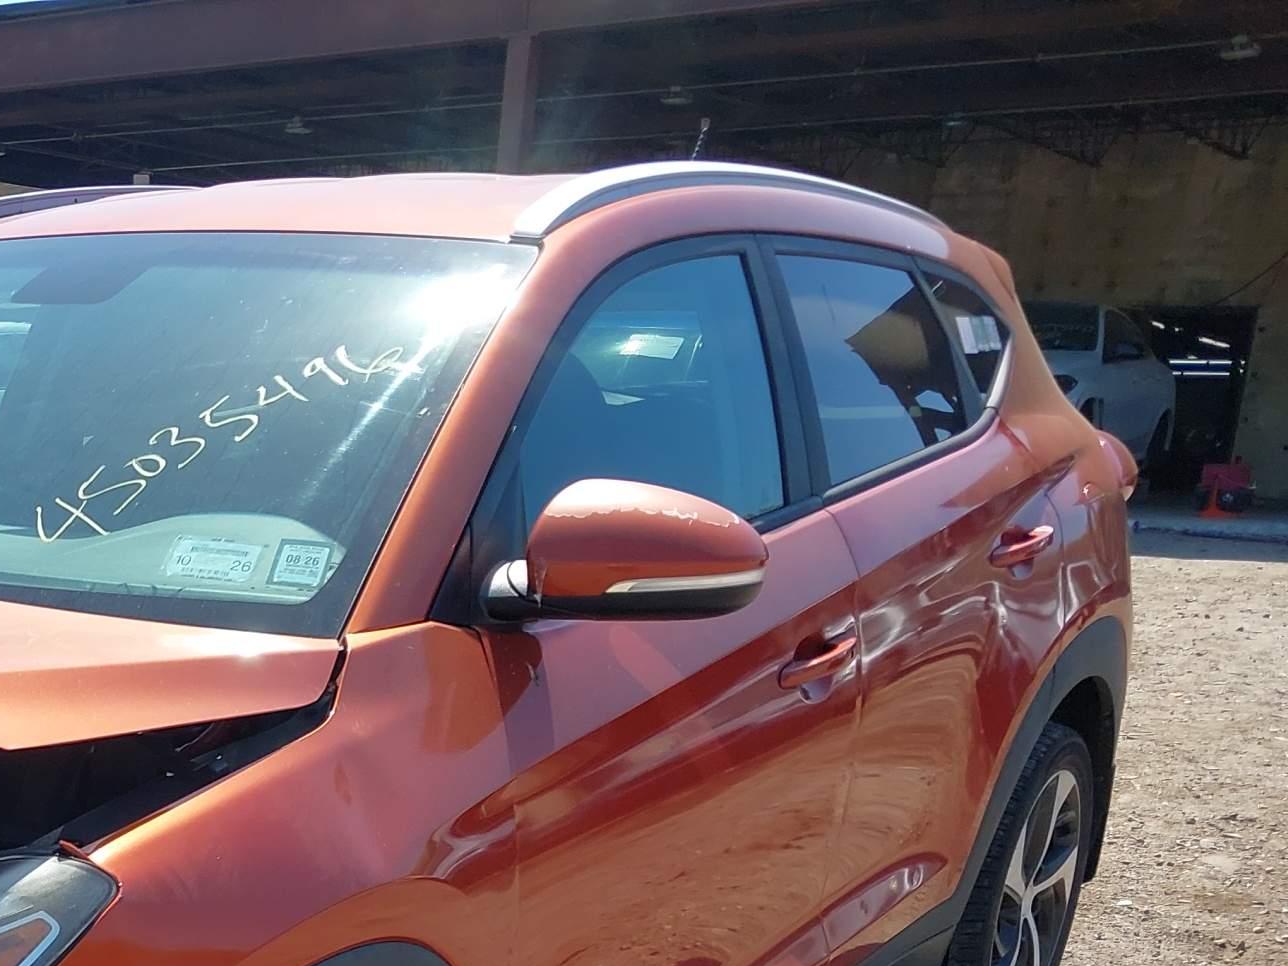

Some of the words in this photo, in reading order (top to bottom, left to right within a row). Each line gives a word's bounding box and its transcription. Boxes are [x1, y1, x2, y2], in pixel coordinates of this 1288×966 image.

[35, 344, 405, 543] 45035496
[176, 554, 192, 566] 10
[230, 559, 253, 573] 26
[285, 554, 301, 564] 08
[304, 555, 320, 566] 26
